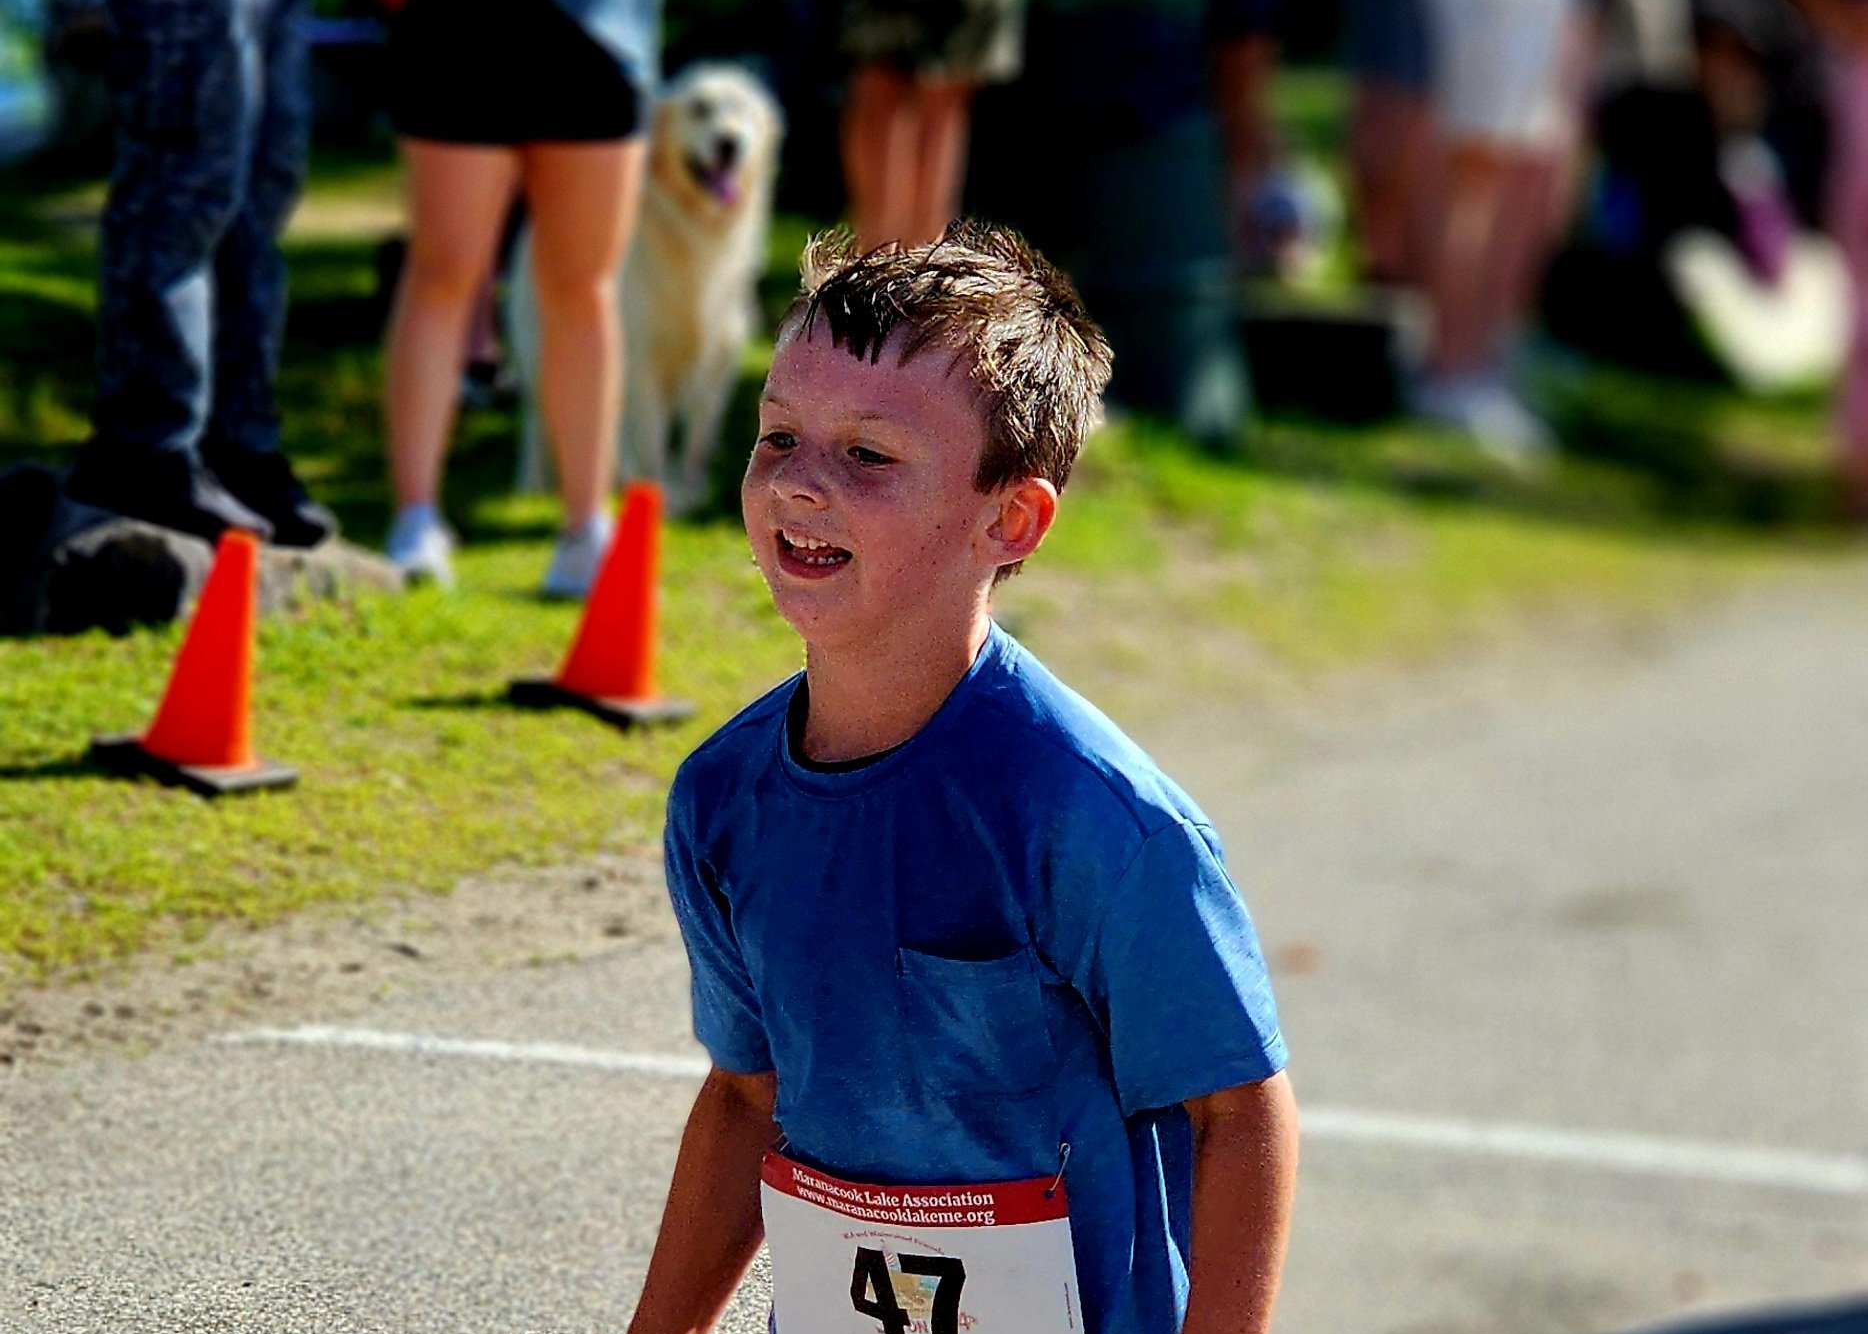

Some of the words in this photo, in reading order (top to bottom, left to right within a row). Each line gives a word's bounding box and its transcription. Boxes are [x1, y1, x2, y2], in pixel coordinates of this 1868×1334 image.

[792, 1167, 864, 1204] Maranacook
[864, 1190, 900, 1207] Lake
[902, 1191, 995, 1208] Association
[796, 1184, 996, 1226] www.maranacooklakeme.org
